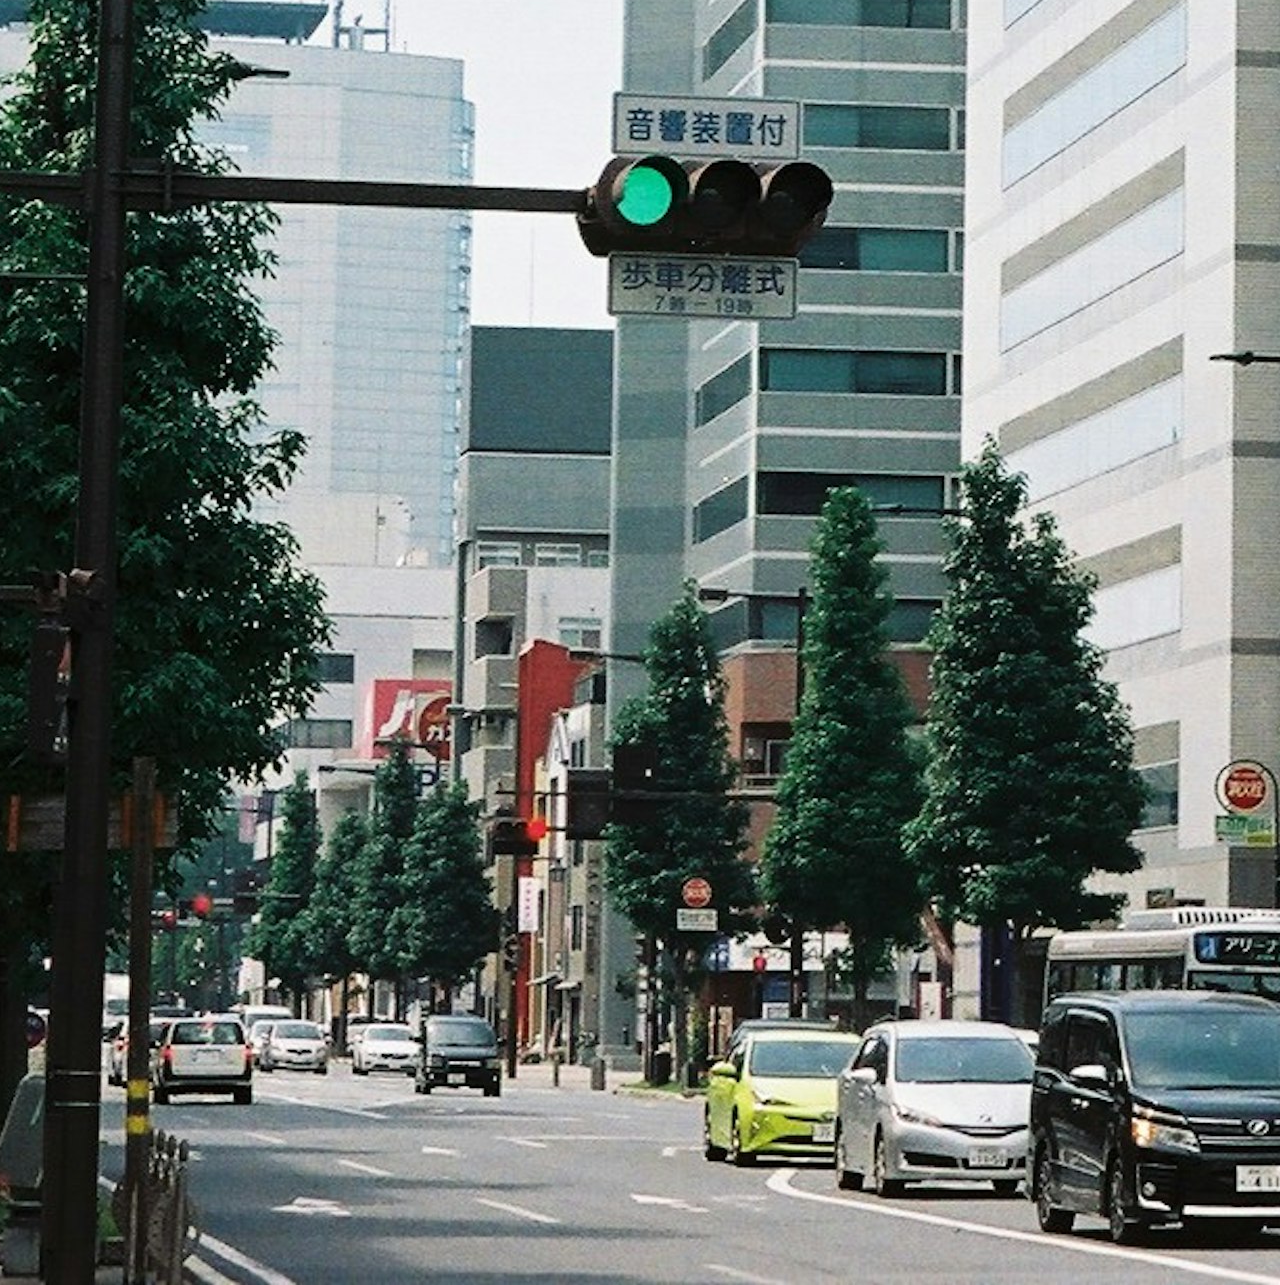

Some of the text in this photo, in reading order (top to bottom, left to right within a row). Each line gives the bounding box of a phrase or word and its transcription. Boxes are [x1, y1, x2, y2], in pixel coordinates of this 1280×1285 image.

[626, 108, 787, 146] 音響装置付
[622, 263, 785, 296] 歩車分離式
